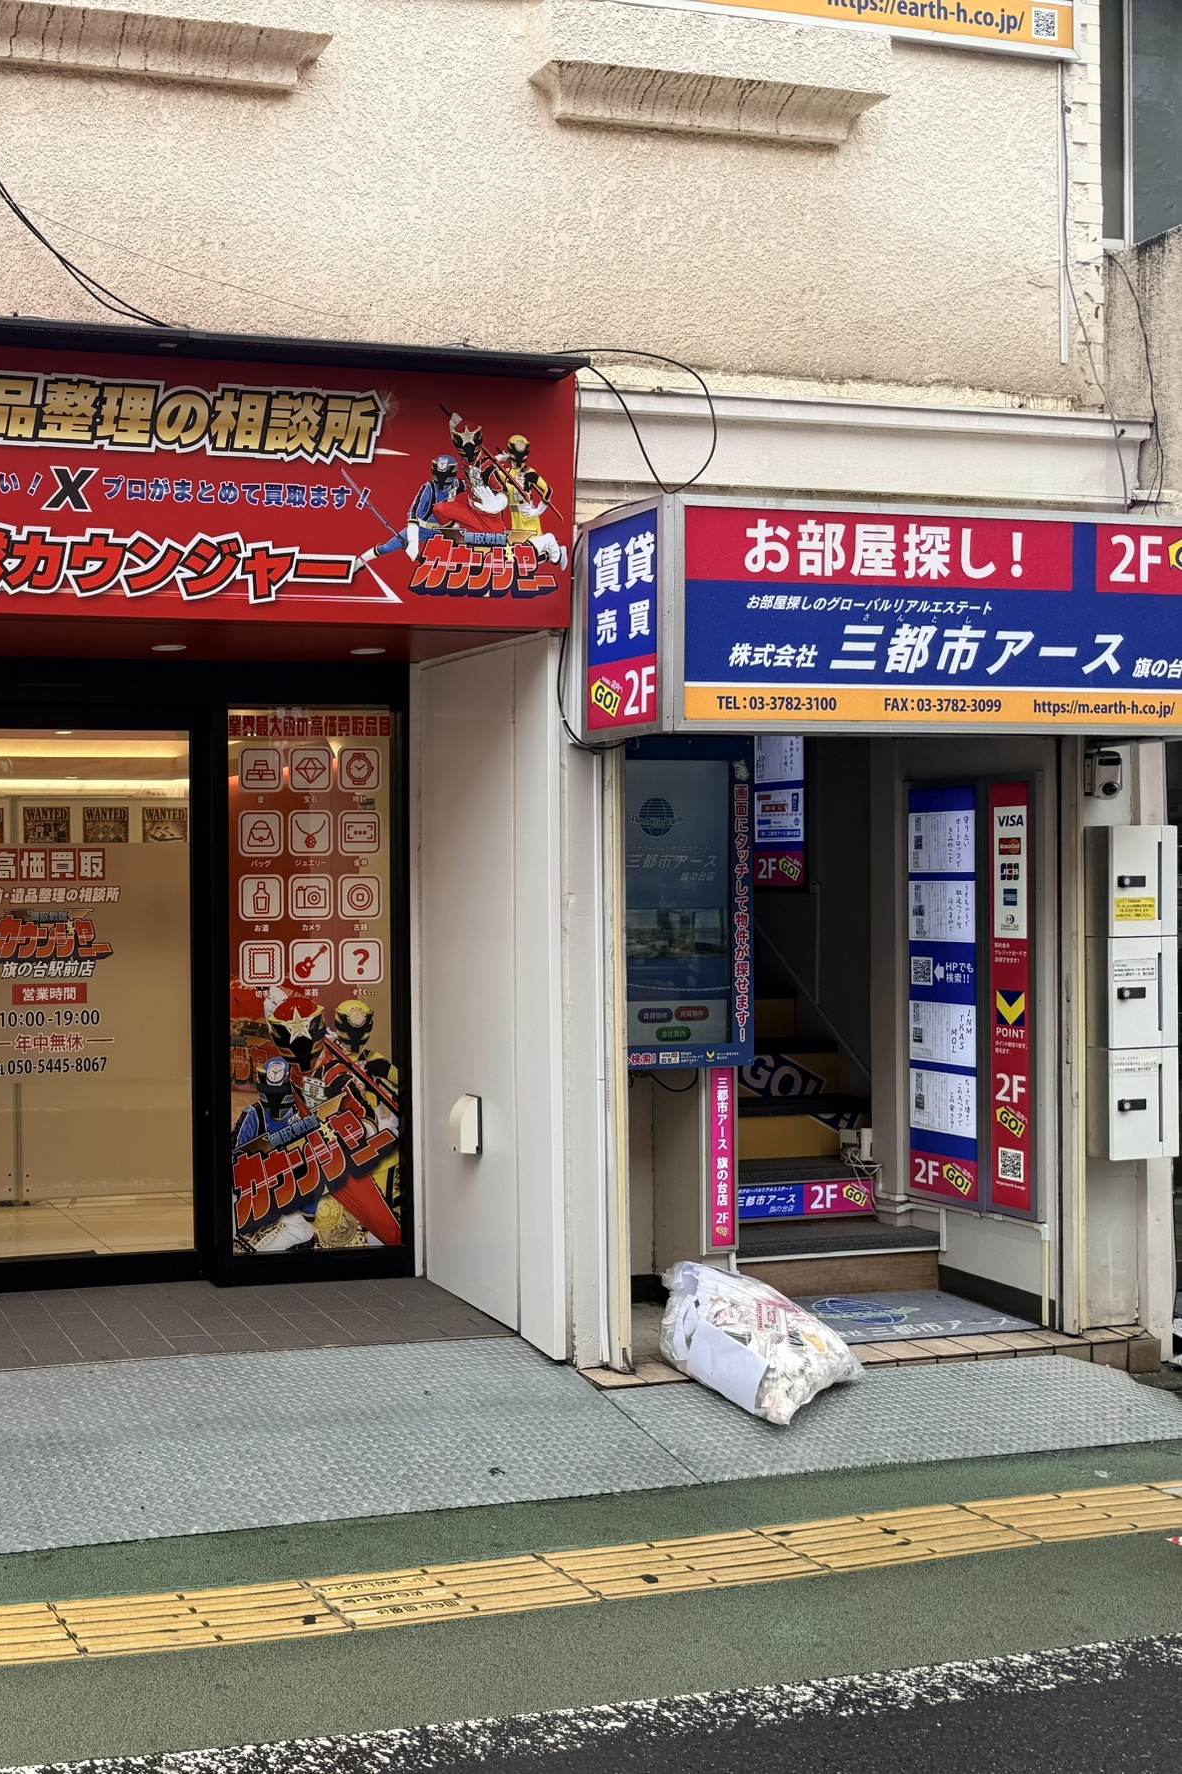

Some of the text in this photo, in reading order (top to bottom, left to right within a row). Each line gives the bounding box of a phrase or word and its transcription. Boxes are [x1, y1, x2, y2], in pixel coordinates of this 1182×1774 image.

[827, 0, 1025, 34] ps://earth-h.co.jp/
[102, 477, 371, 510] プロがまとめて買取ます！
[743, 519, 1022, 581] お部屋探し！
[1109, 534, 1162, 583] 2F
[408, 534, 558, 598] カウンジャー
[592, 530, 656, 599] 賃貸
[746, 594, 993, 615] お部屋探しのグローバルリアルエステート
[595, 600, 651, 647] 売買
[727, 642, 818, 669] 株式会社
[829, 623, 1125, 676] 三都市アース
[594, 685, 618, 714] GO!
[624, 665, 655, 716] 2F
[1033, 697, 1175, 719] https://m.earth-h.co.jp/
[228, 715, 392, 737] 業界最大級の高価買取品目
[26, 808, 68, 820] WANTED
[86, 808, 127, 820] WANTED
[145, 808, 186, 820] WANTED
[997, 815, 1024, 827] VISA
[758, 857, 777, 879] 2F
[780, 860, 799, 880] GO!
[733, 783, 751, 1043] 画面にタッチして物件が探せます！
[301, 923, 322, 931] カメラ
[1, 961, 95, 979] 旗の台駅前店
[945, 962, 974, 973] HPでも
[22, 987, 77, 1002] 営業時間
[15, 1033, 85, 1053] 年中無休
[996, 1027, 1025, 1039] POINT
[7, 1057, 108, 1076] 050-5445-8067
[995, 1073, 1026, 1103] 2F
[999, 1111, 1023, 1136] GO!
[716, 1077, 728, 1207] 三都市アース 旗の台店
[914, 1158, 940, 1185] 2F
[945, 1167, 970, 1193] GO!
[811, 1184, 838, 1210] 2F
[845, 1187, 866, 1206] GO!
[715, 1212, 729, 1224] 2F
